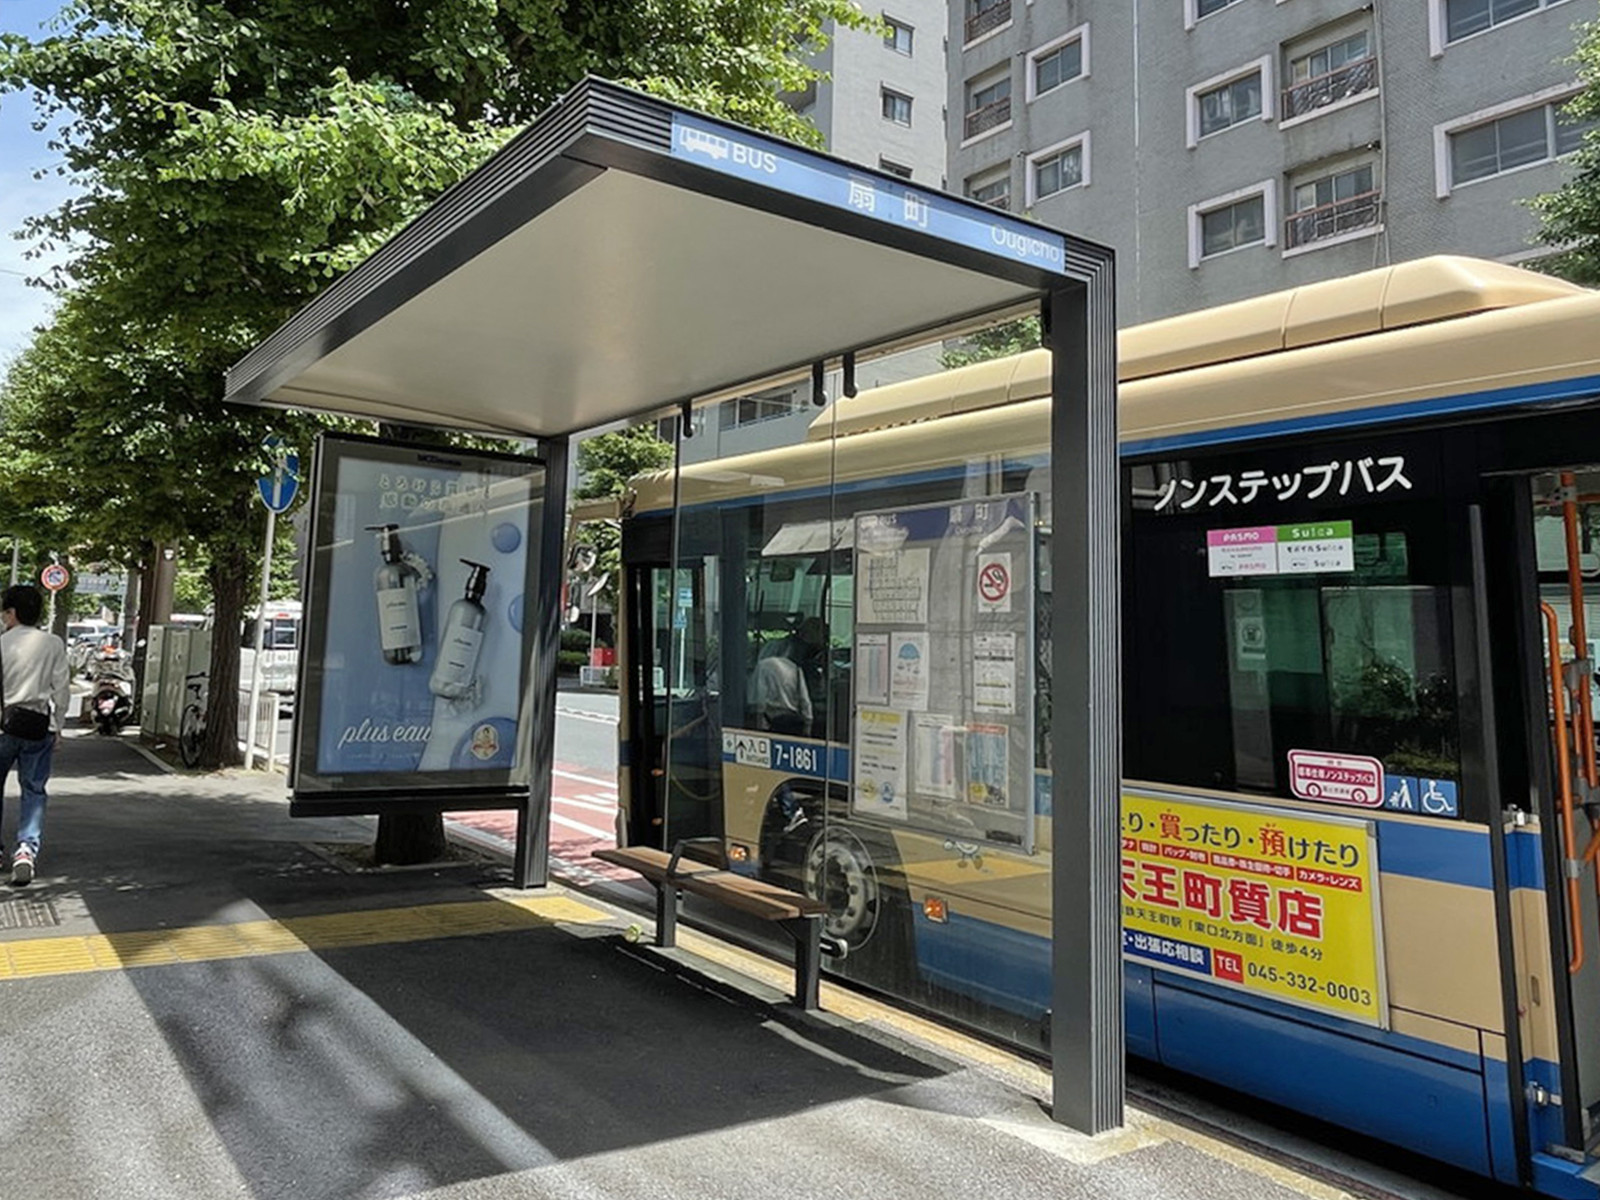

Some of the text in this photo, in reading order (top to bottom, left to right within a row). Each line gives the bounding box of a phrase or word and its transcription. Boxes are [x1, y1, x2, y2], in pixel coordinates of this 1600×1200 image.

[732, 144, 777, 175] BUS
[1154, 456, 1412, 512] ノンステップバス
[1223, 531, 1260, 542] PASMO
[1291, 526, 1334, 539] Suica
[337, 718, 432, 750] plus eau
[775, 743, 817, 772] 7-1861
[1298, 870, 1360, 889] カメラ・レンズ
[1122, 931, 1204, 965] ・出張応相談
[1216, 954, 1372, 1006] TEL 045-332-0003
